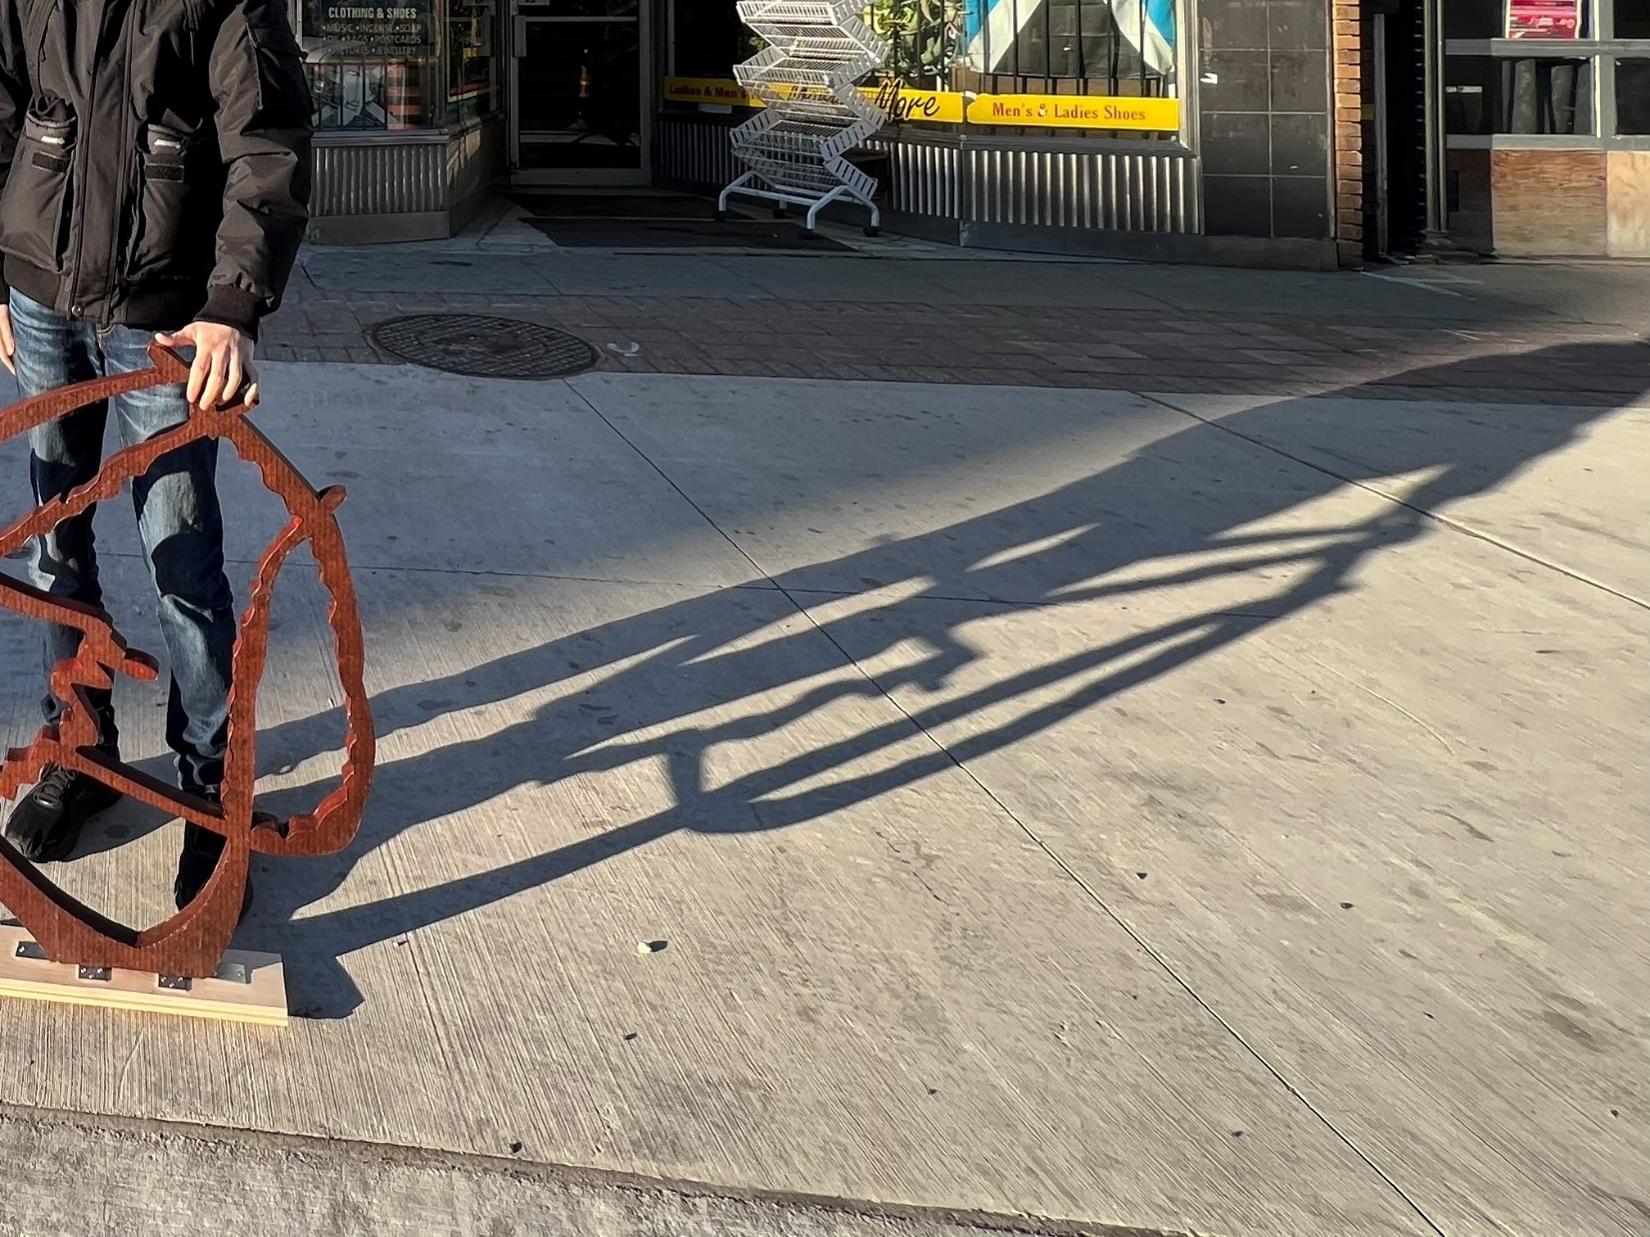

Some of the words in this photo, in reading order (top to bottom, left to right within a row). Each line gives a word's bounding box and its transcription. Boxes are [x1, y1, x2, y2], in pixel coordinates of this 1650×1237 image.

[328, 7, 375, 19] CLOTHING
[376, 7, 385, 19] &
[386, 7, 418, 20] SHOES
[992, 102, 1033, 117] Men's
[1053, 103, 1099, 120] Ladies
[1103, 104, 1146, 121] Shoes
